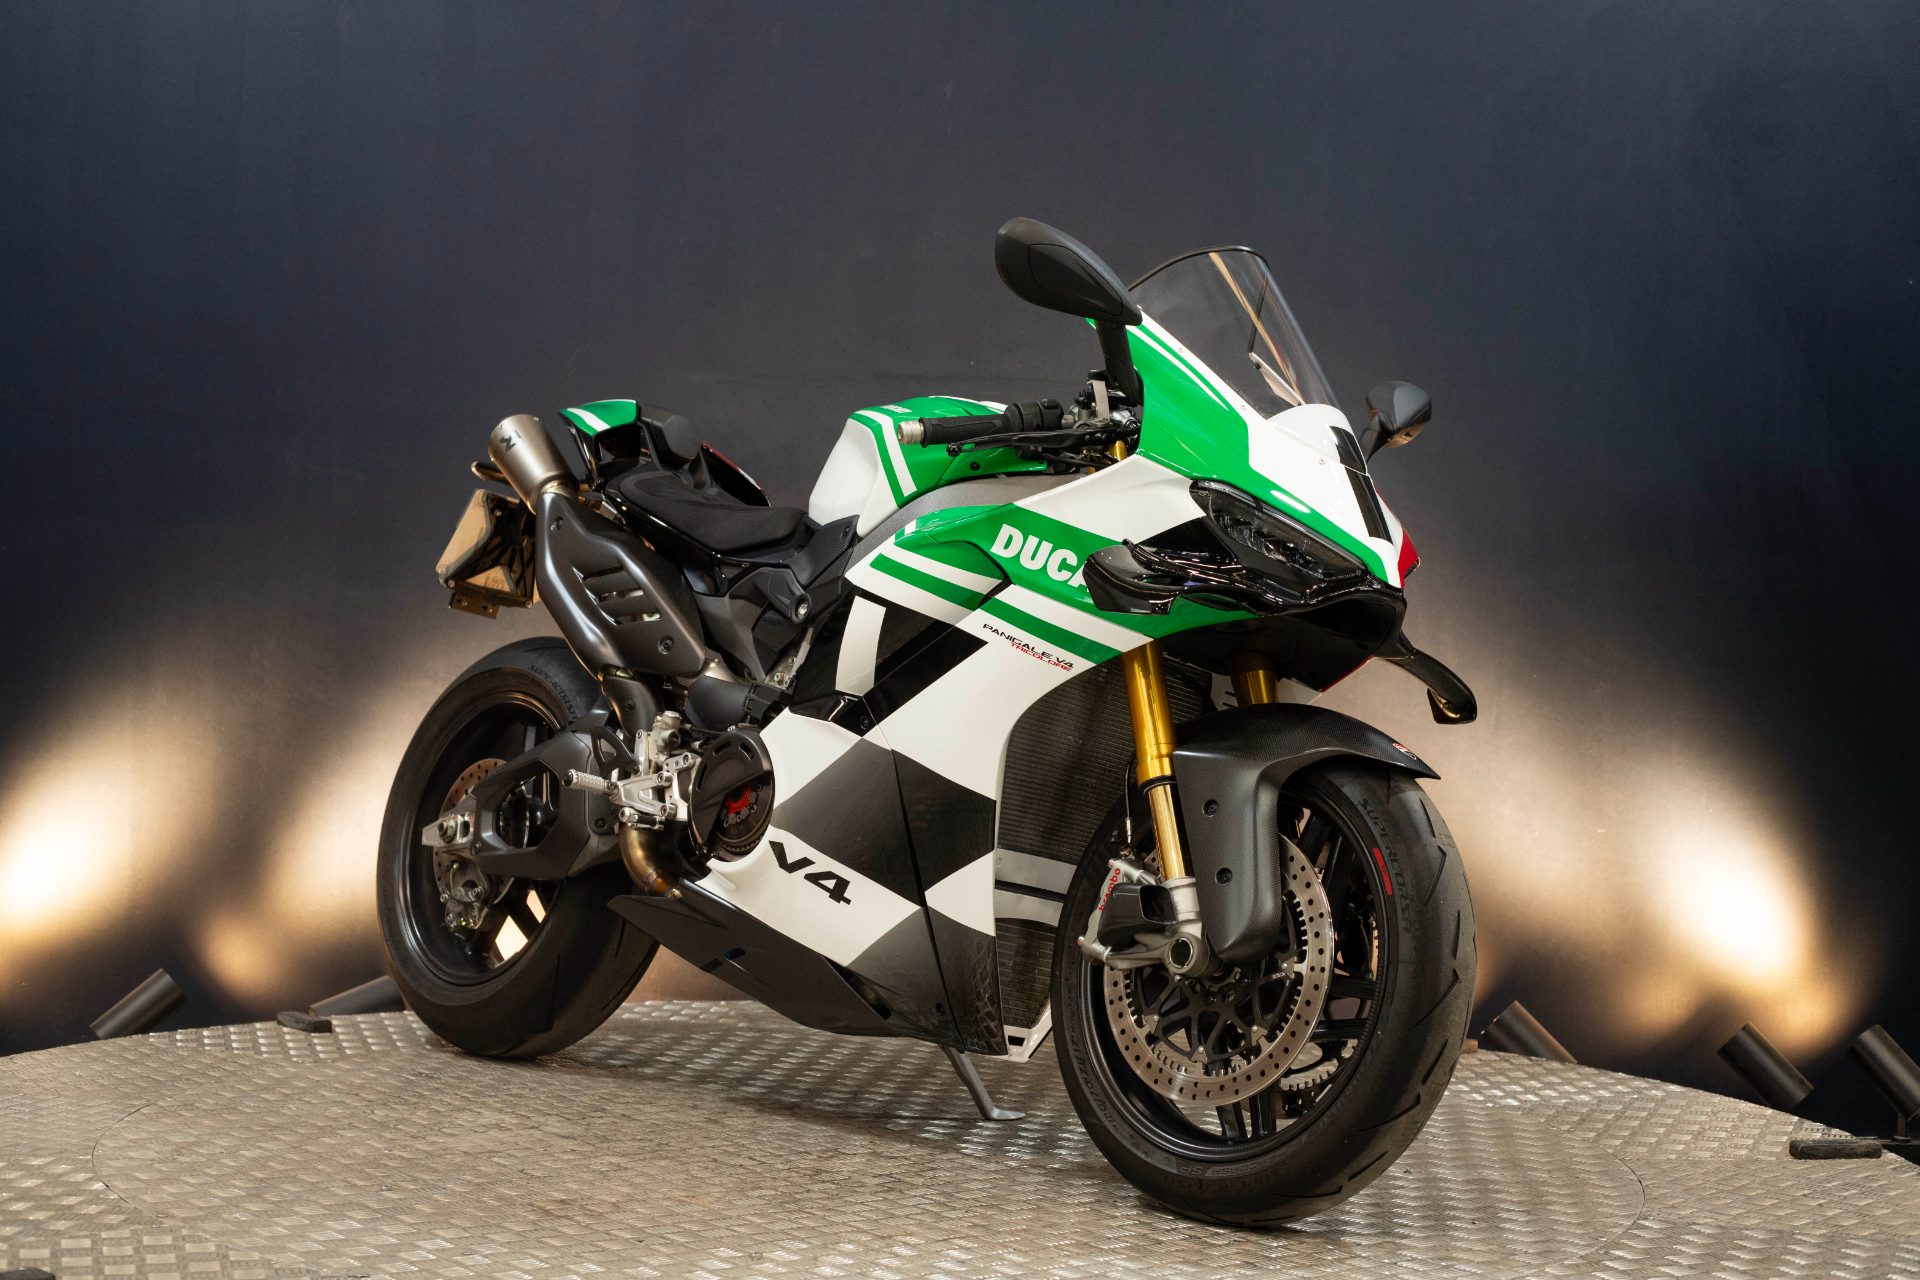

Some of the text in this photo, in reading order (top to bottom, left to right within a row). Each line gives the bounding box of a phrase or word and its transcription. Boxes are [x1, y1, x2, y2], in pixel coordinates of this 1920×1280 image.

[983, 623, 1074, 668] PANIGALE V4
[1010, 641, 1073, 673] TRICOLORE
[768, 840, 852, 905] V4
